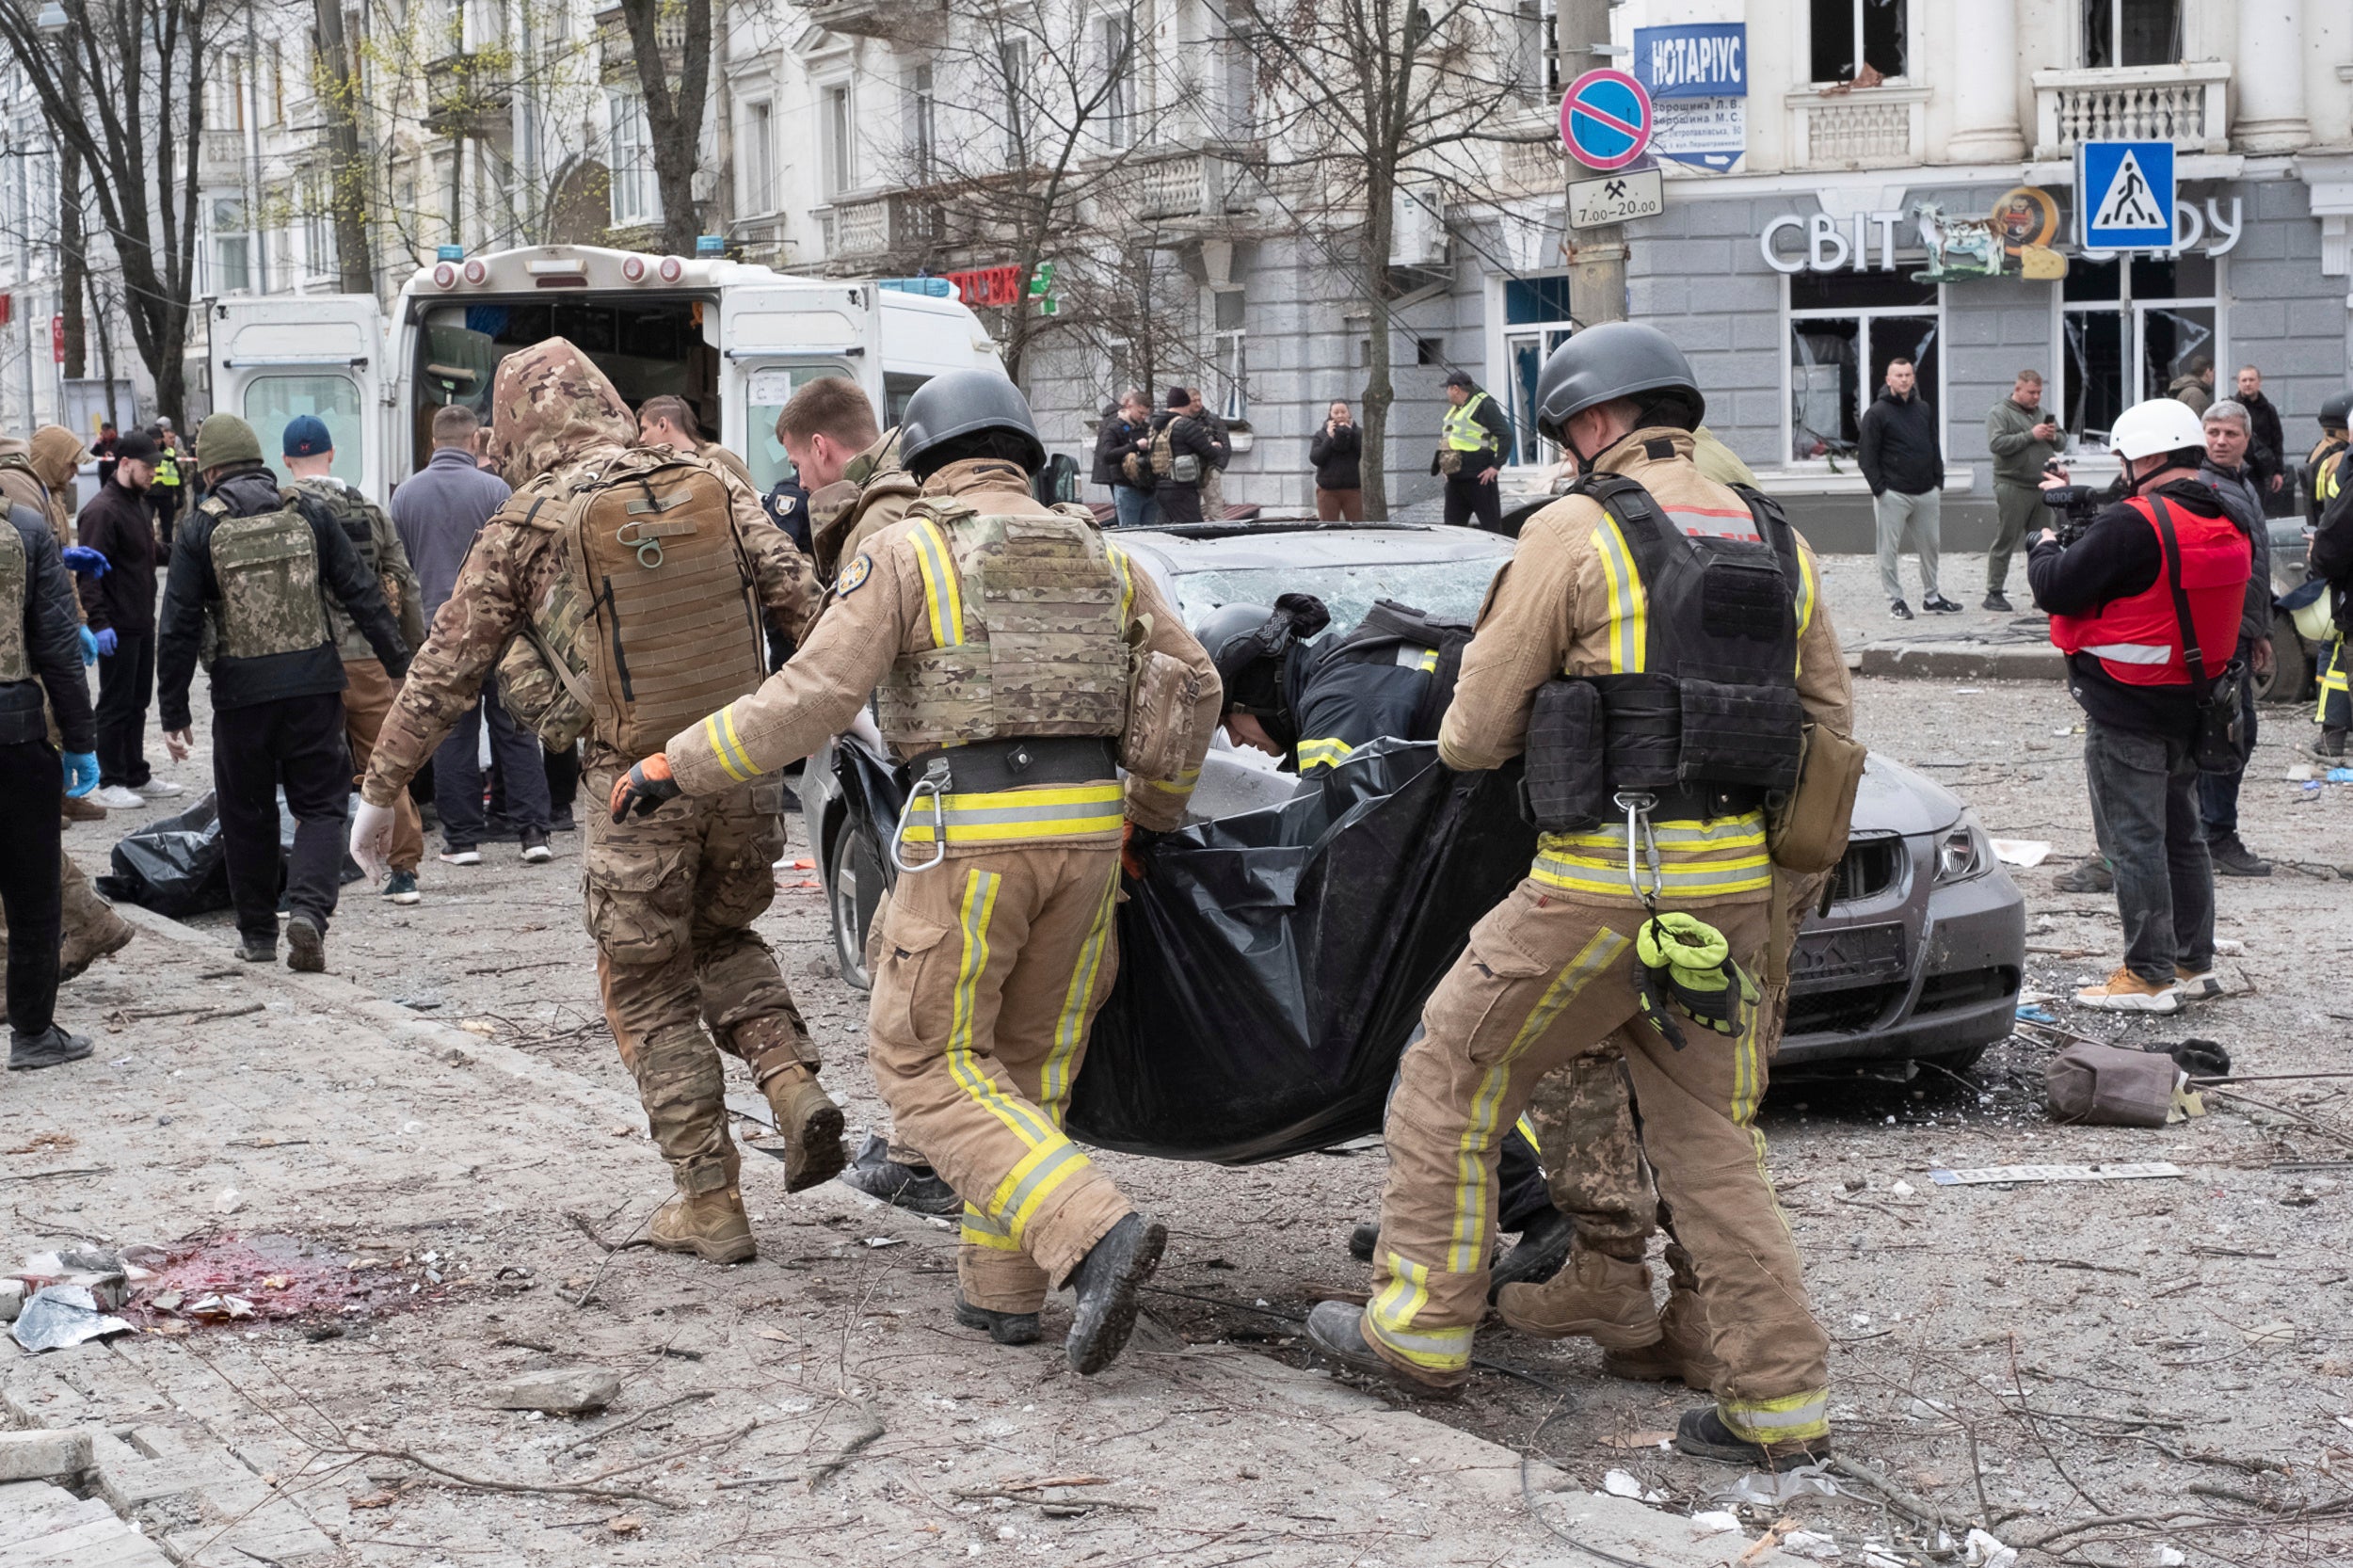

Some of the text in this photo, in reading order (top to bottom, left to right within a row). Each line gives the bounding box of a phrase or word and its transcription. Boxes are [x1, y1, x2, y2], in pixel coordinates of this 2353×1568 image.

[1652, 36, 1741, 86] НОТАРІУС
[1652, 102, 1710, 113] Ворошина
[1761, 197, 2243, 273] СВІТ РУ
